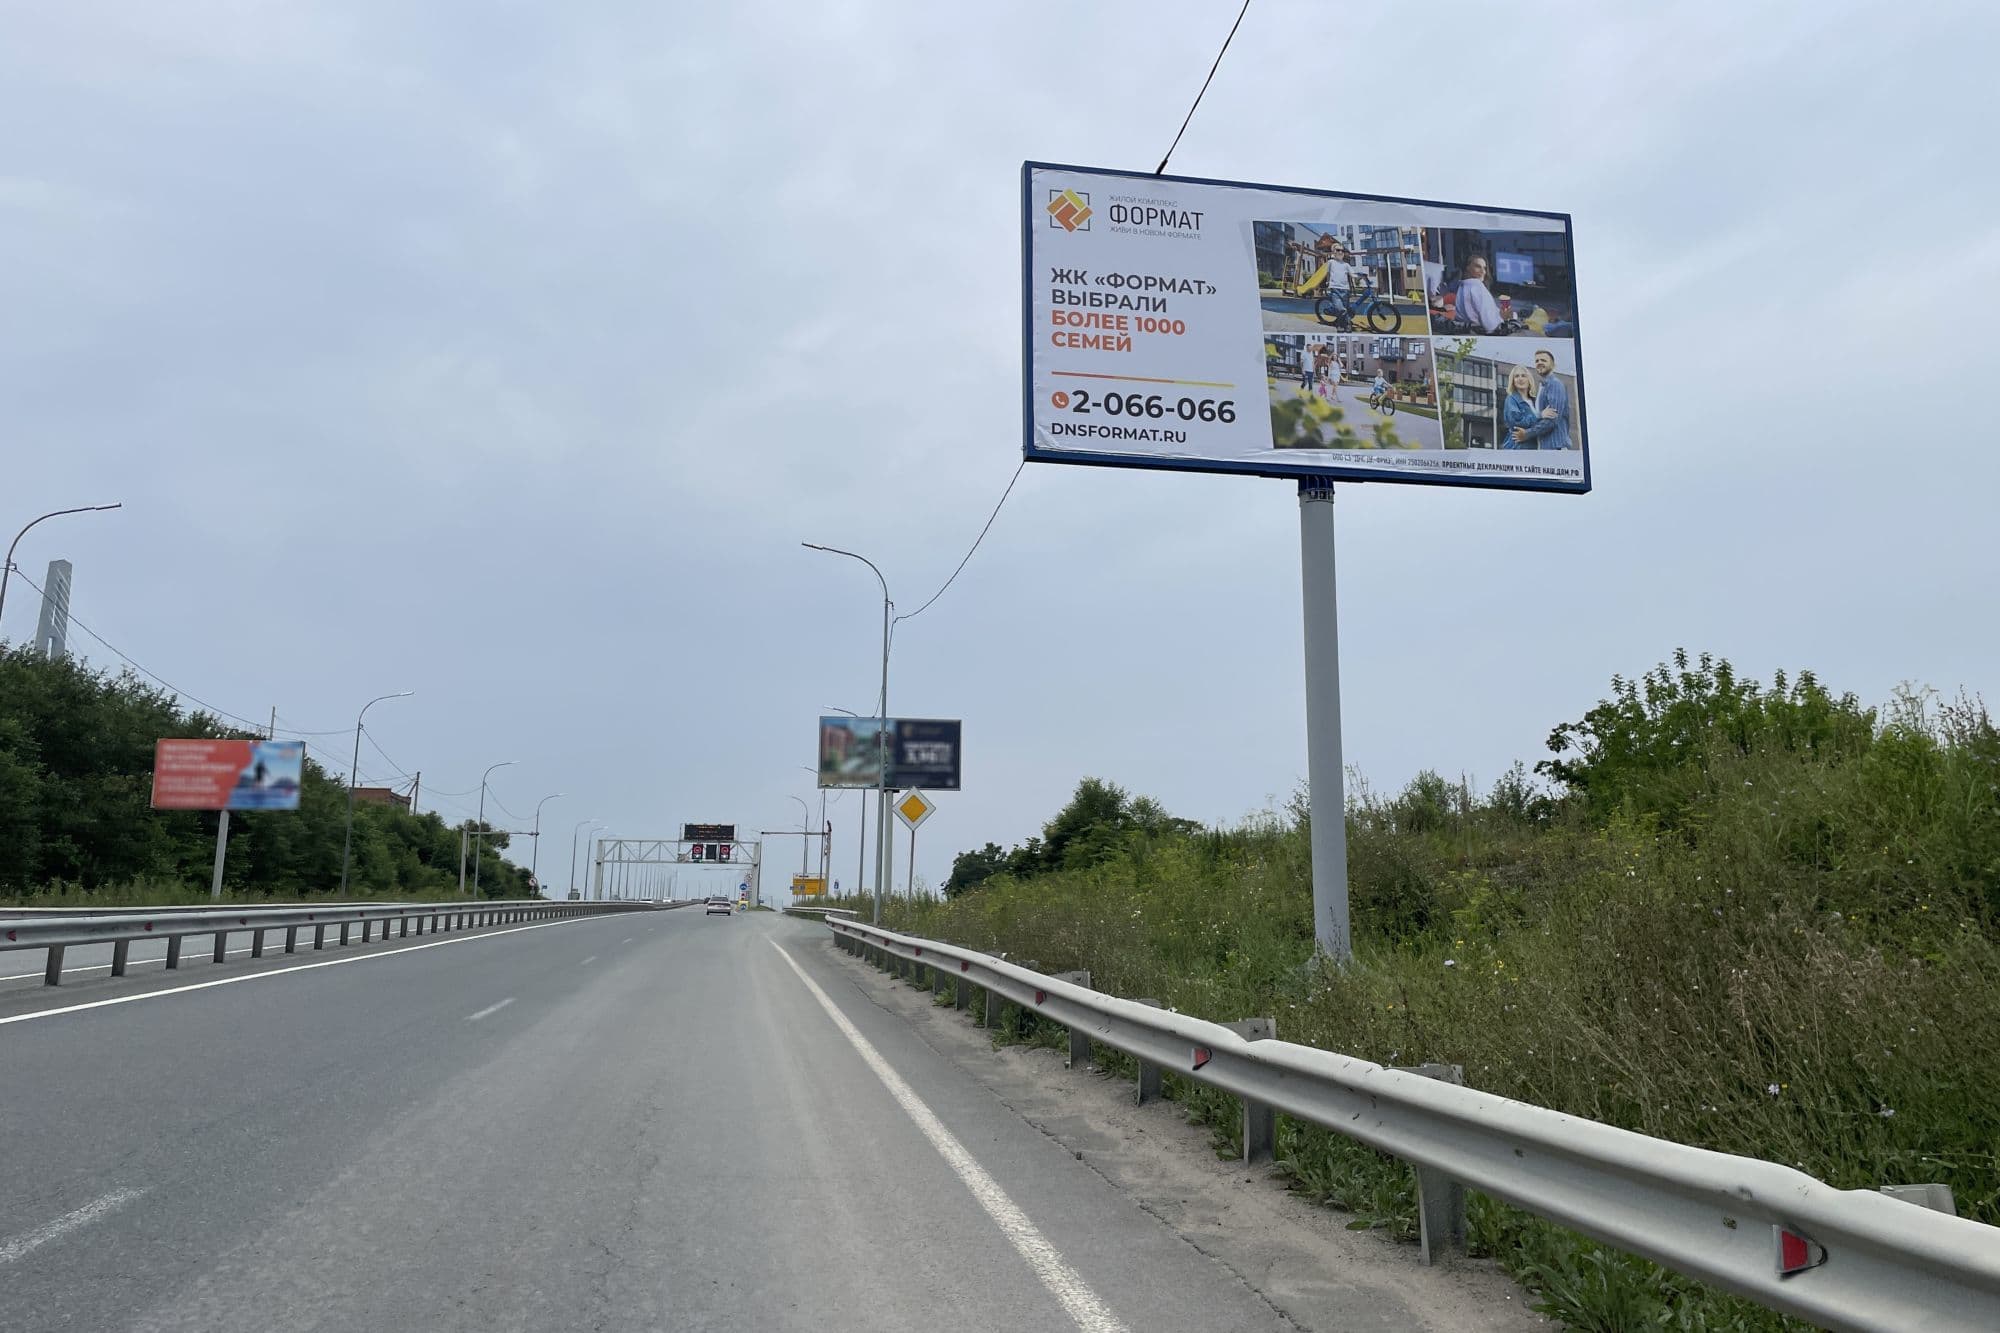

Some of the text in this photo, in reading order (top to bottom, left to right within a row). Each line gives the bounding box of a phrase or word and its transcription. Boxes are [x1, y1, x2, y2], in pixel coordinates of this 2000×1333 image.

[1138, 197, 1178, 208] КОМПЛЕКС
[1110, 203, 1204, 231] ФОРМАТ
[1051, 267, 1217, 295] ЖК «ФОРМАТ»
[1052, 289, 1167, 313] ВЫБРАЛИ
[1052, 309, 1186, 336] БОЛЕЕ 1000
[1051, 331, 1132, 352] СЕМЕЙ
[1071, 389, 1236, 424] 2-066-066
[1051, 422, 1187, 443] DNSFORMAT.RU
[1442, 460, 1476, 470] ПРОЕКТНЫЕ
[1477, 462, 1514, 472] ДЕКЛАРАЦИИ
